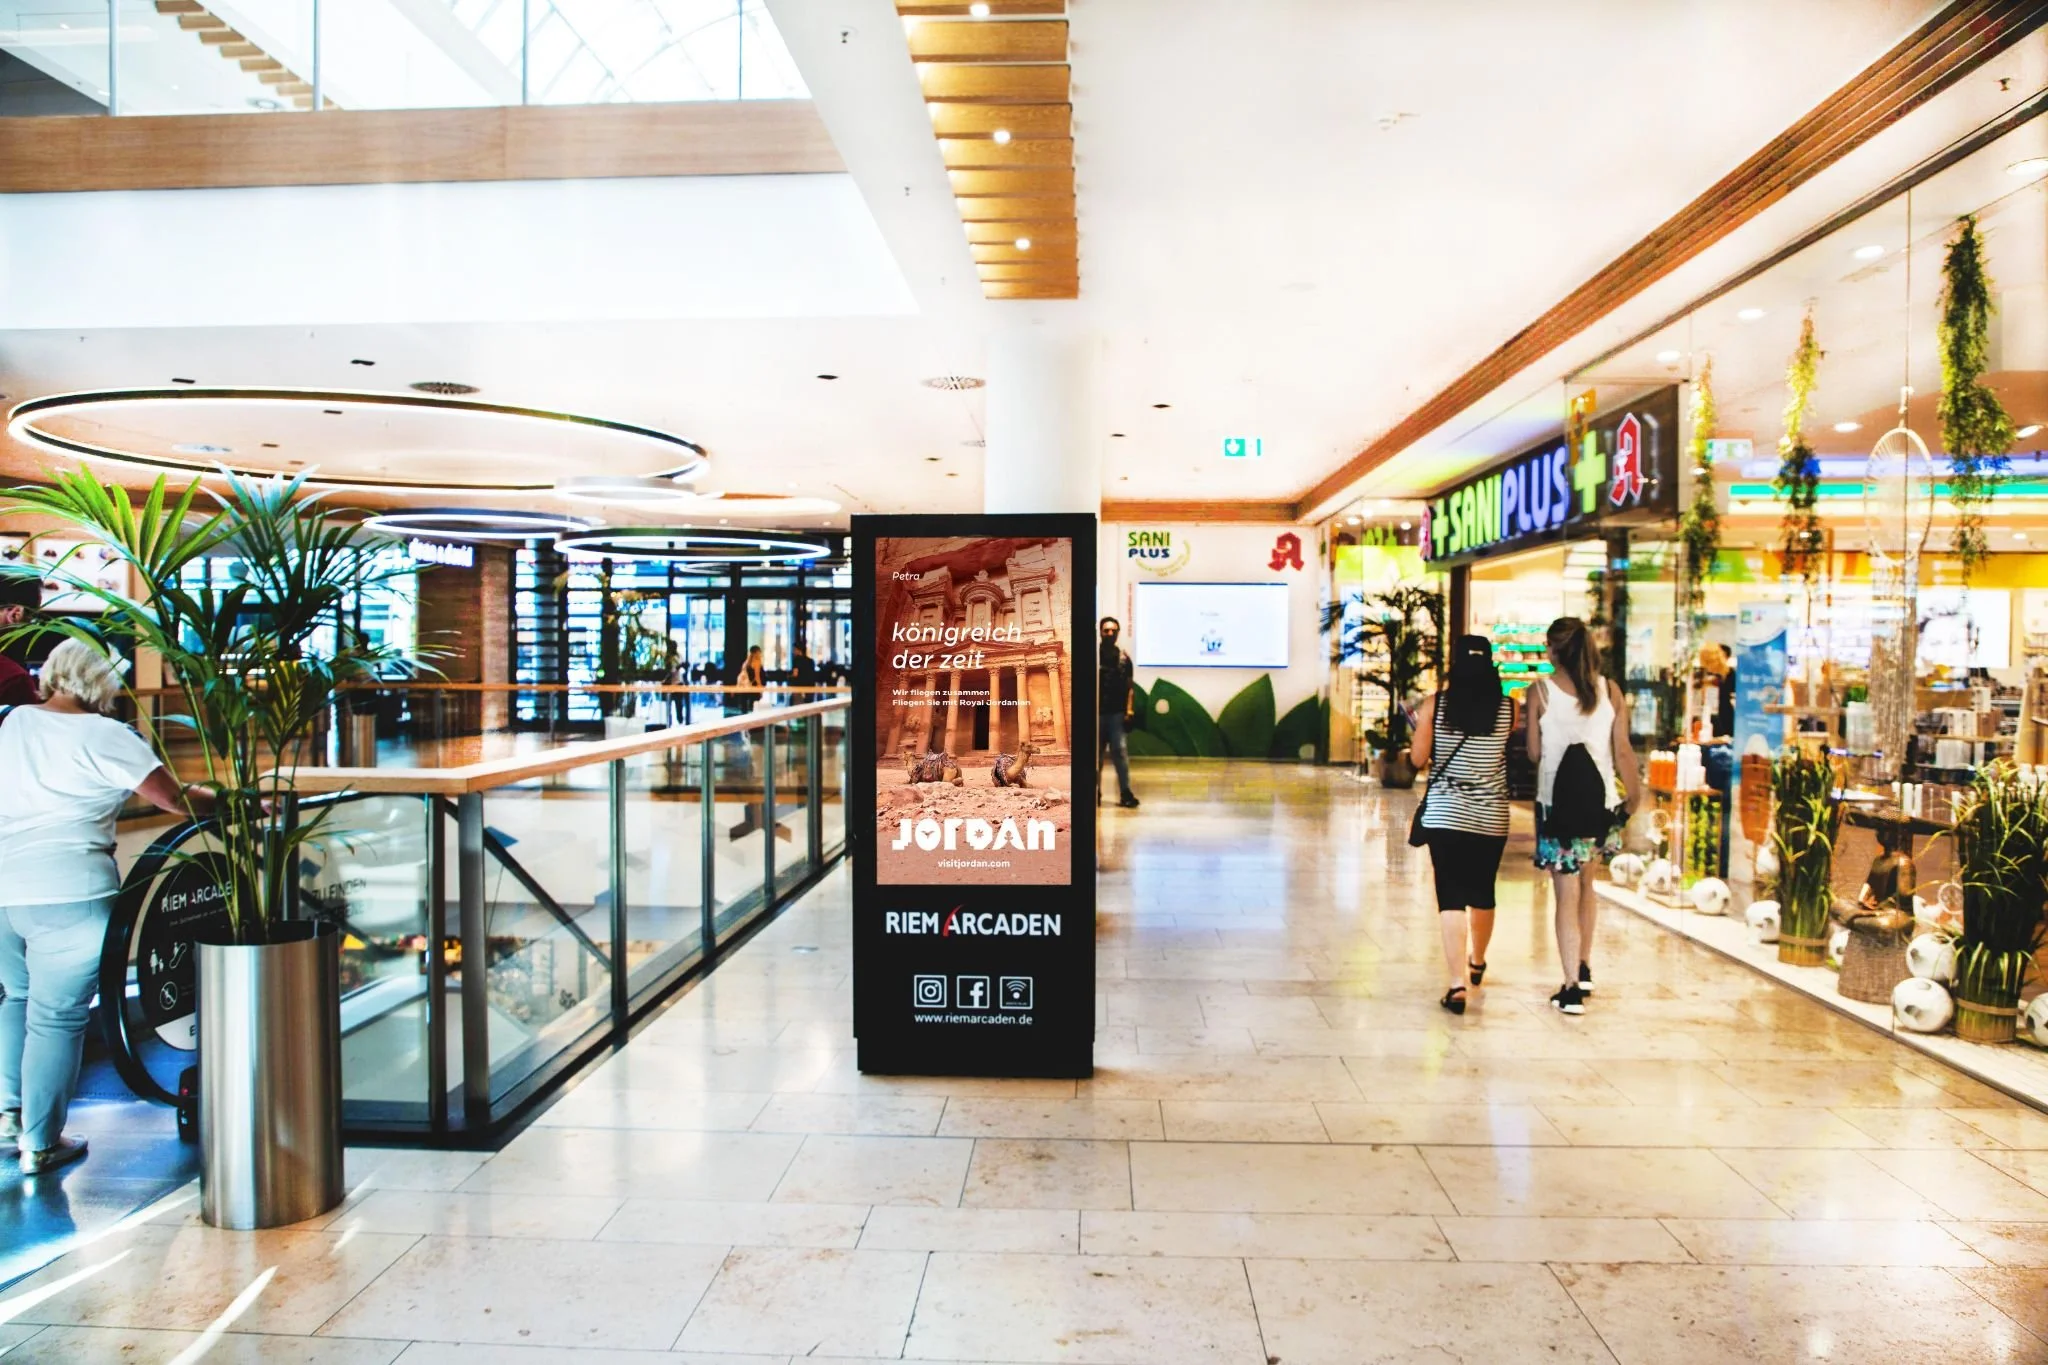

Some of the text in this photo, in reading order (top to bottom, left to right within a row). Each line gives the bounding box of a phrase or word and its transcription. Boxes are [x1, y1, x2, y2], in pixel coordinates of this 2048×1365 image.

[1448, 444, 1571, 553] SANIPLUS
[1128, 531, 1171, 547] SANI
[1128, 548, 1170, 558] PLUS
[892, 571, 920, 581] Petra
[892, 621, 1022, 647] königreich
[892, 649, 985, 669] der zeit
[910, 689, 941, 698] fliegen
[892, 699, 924, 708] Fliegen
[960, 699, 984, 708] Royal
[937, 859, 1010, 869] visitjordan.com
[161, 880, 233, 913] RIEM ARCADE
[885, 908, 1061, 937] RIEM ARCADEN
[914, 1012, 1033, 1025] www.riemarcaden.de
